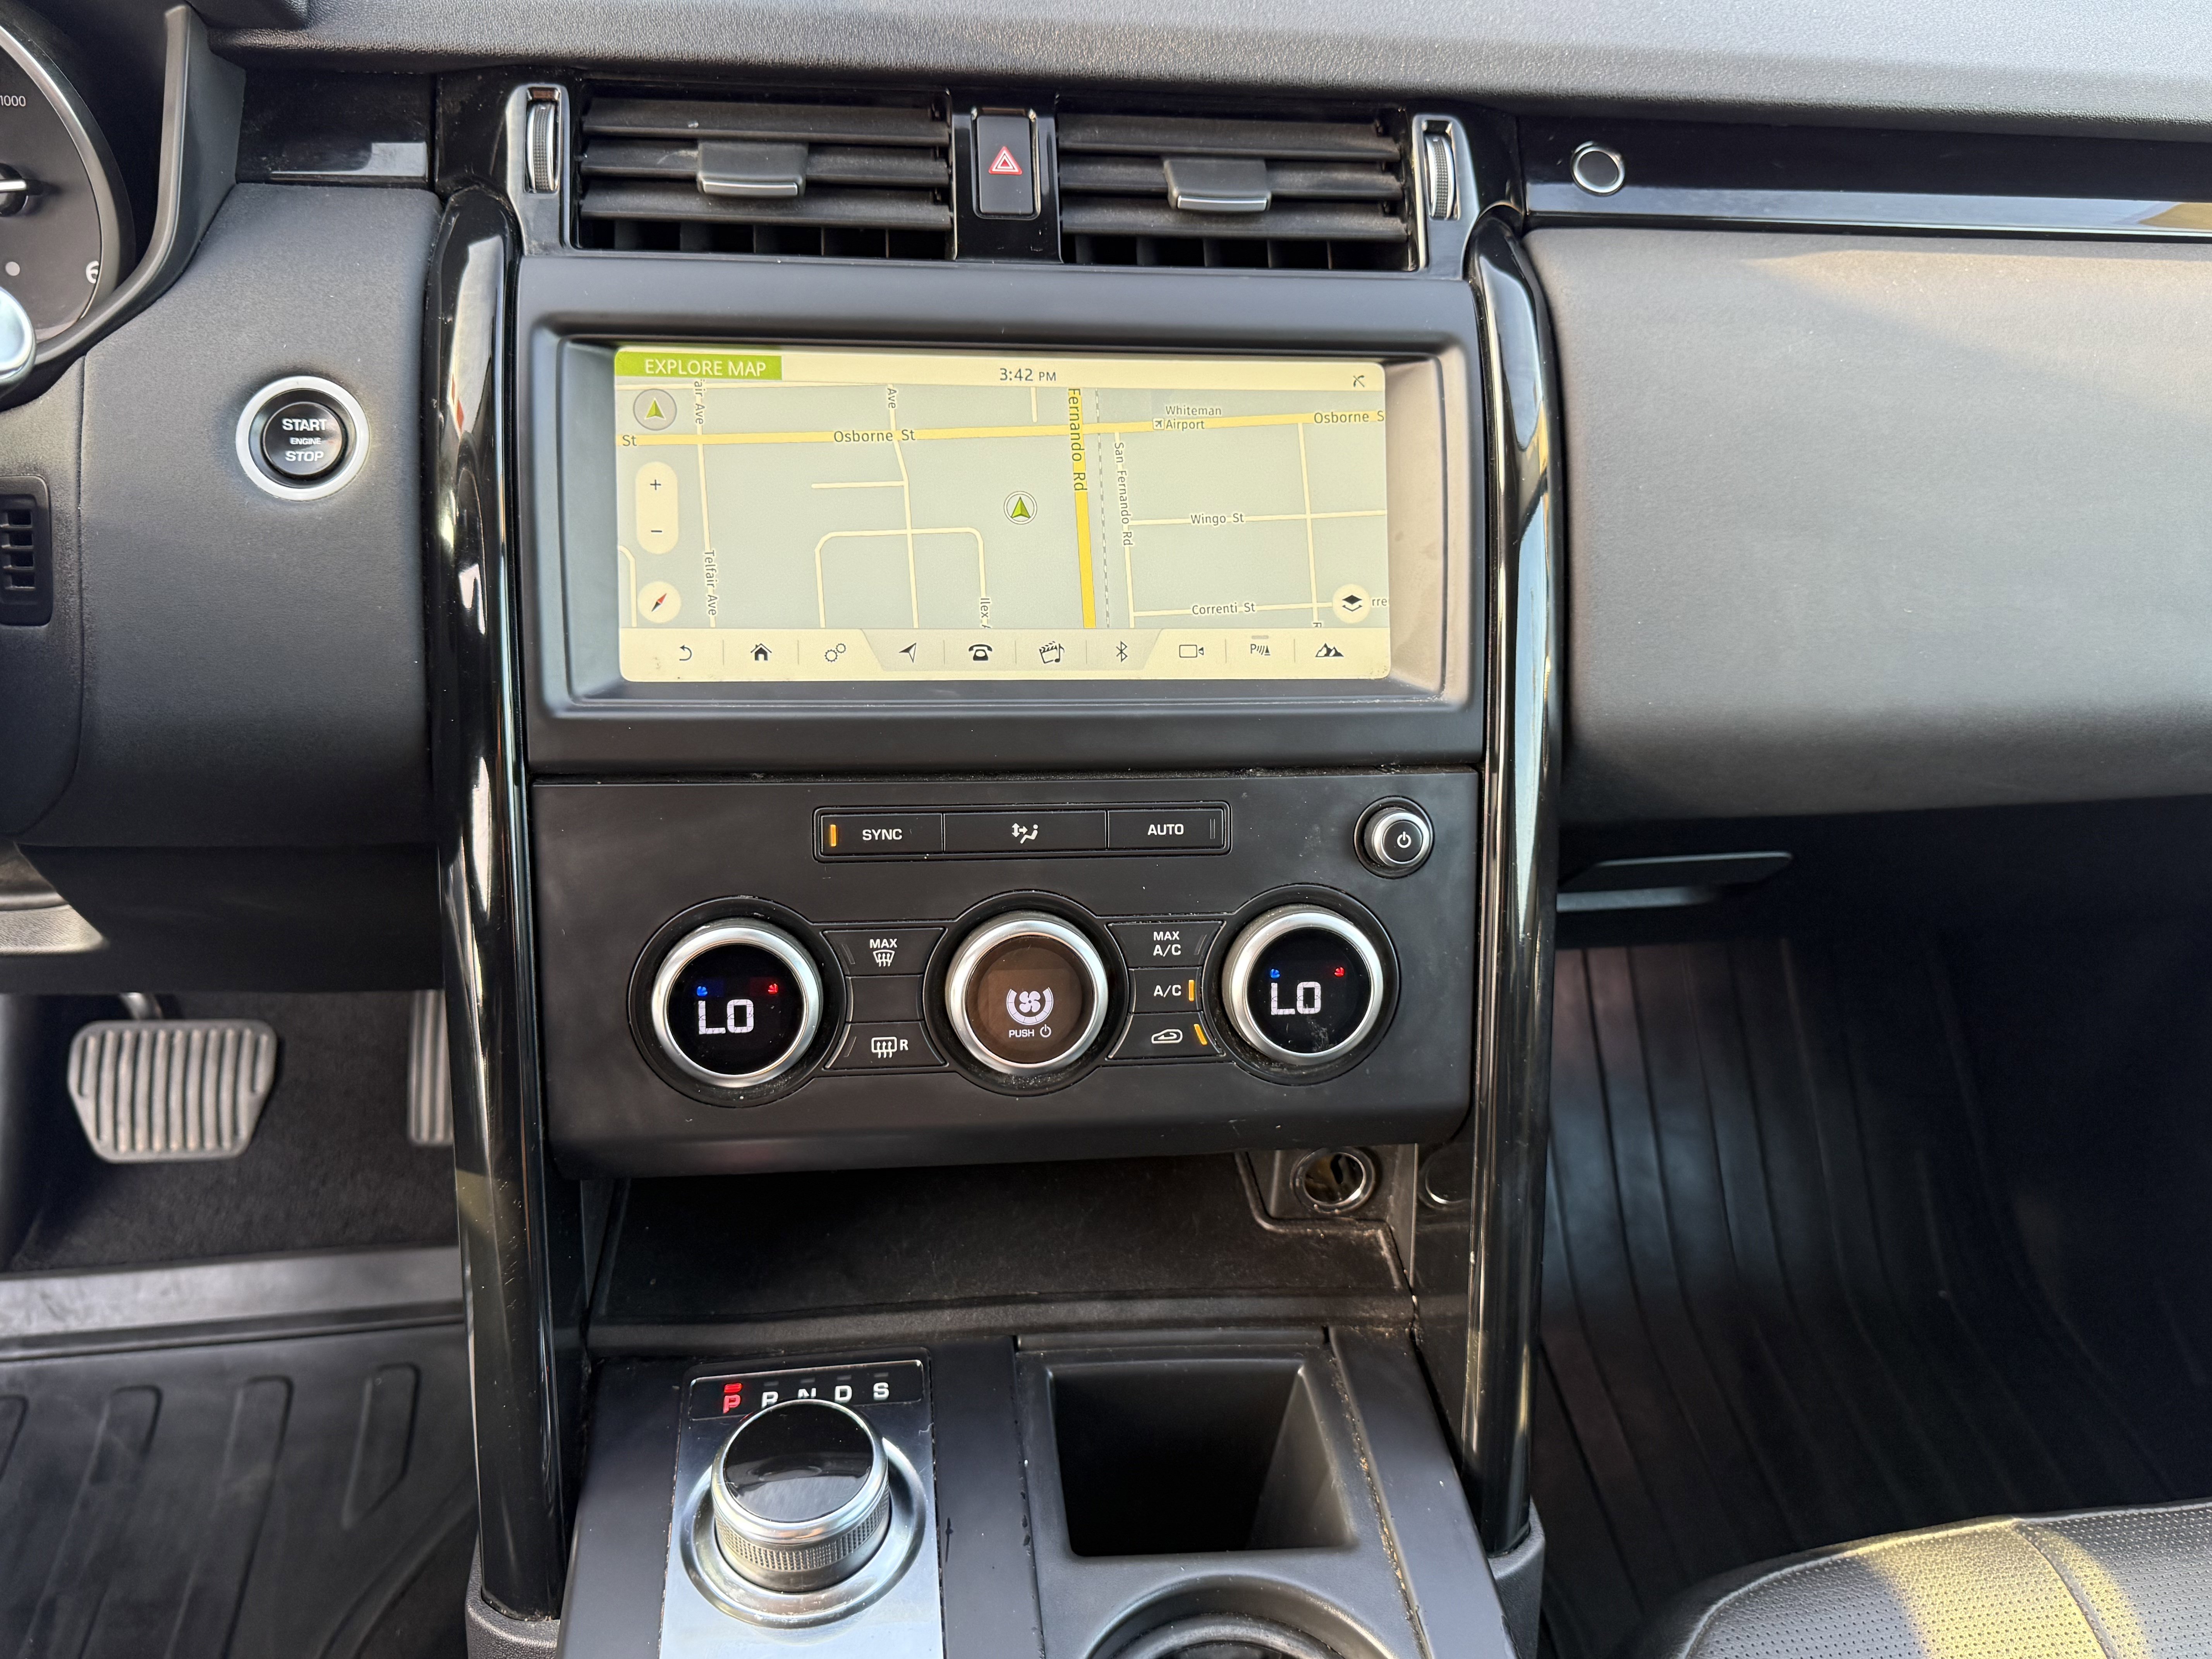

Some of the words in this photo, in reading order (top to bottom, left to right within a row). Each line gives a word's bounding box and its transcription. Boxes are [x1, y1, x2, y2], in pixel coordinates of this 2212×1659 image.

[645, 359, 723, 376] EXPLORE
[728, 361, 766, 377] MAP
[1000, 368, 1033, 381] 3:42
[1039, 372, 1056, 381] PM
[694, 379, 706, 397] air
[888, 388, 897, 408] Ave
[696, 403, 705, 424] Ave
[1166, 406, 1221, 416] Whiteman
[282, 418, 327, 431] START
[1068, 388, 1084, 461] Fernando
[1314, 412, 1369, 424] Osborne
[1166, 419, 1205, 431] Airport
[622, 435, 637, 447] St
[834, 430, 893, 441] Osborne
[902, 429, 915, 441] St
[285, 451, 324, 462] STOP
[1114, 442, 1124, 463] San
[1073, 472, 1087, 491] Rd
[1117, 470, 1131, 524] Fernando
[1191, 514, 1226, 526] Wingo
[1233, 513, 1244, 523] St
[1123, 531, 1133, 546] Rd
[704, 550, 717, 587] Telfair
[708, 595, 718, 615] Ave
[1192, 603, 1237, 615] Correnti
[1244, 602, 1255, 612] St
[862, 828, 903, 841] SYNC
[1147, 823, 1184, 836] AUTO
[1153, 931, 1180, 941] MAX
[870, 939, 897, 949] MAX
[1152, 943, 1181, 956] A/C
[1153, 983, 1182, 997] A/C
[1271, 981, 1321, 1015] LO
[698, 999, 754, 1035] LO
[1009, 1029, 1035, 1038] PUSH
[900, 1039, 908, 1051] R
[723, 1395, 741, 1413] P
[835, 1386, 852, 1403] D
[873, 1382, 889, 1400] S
